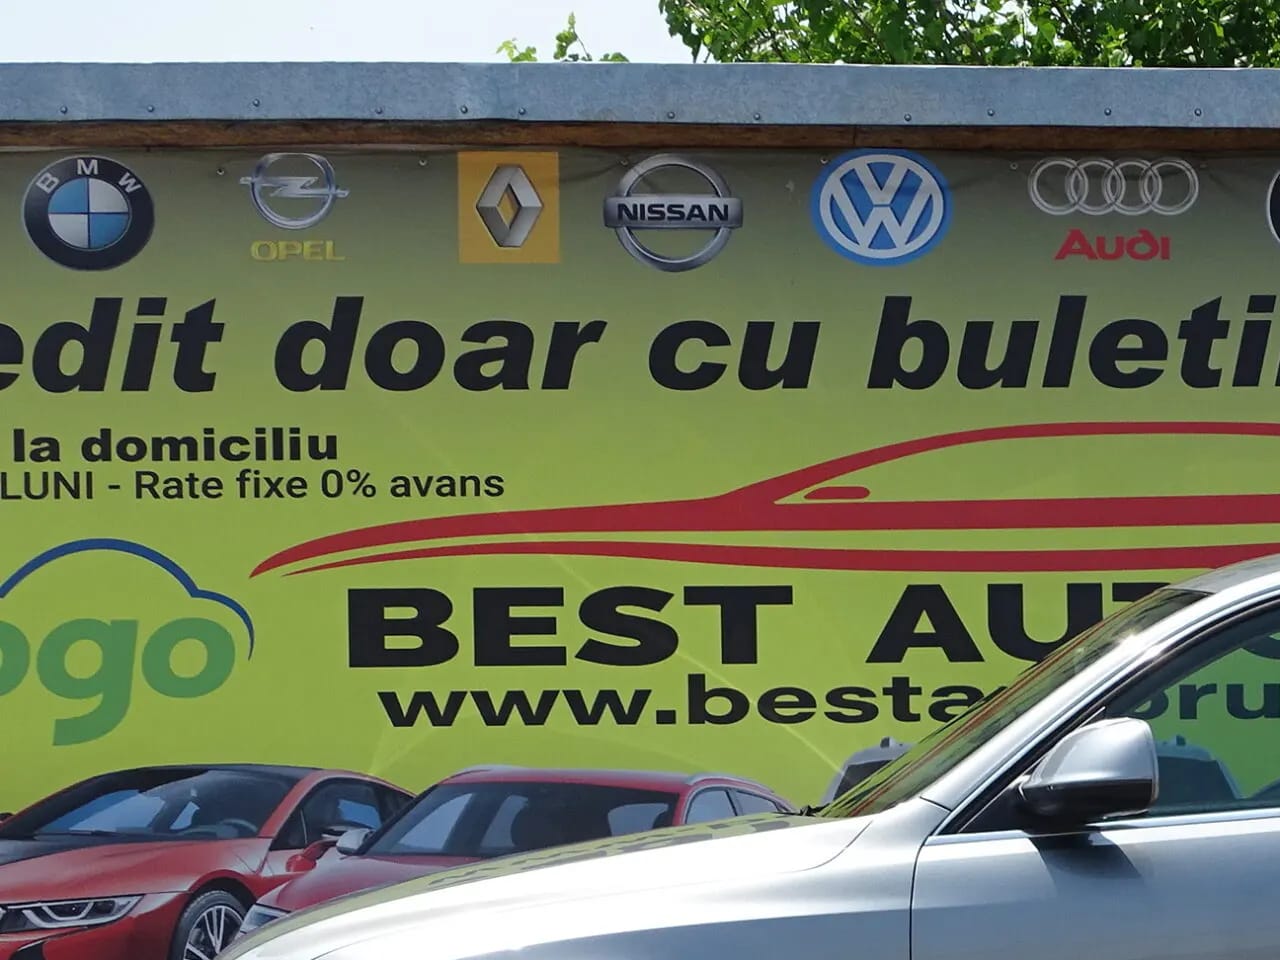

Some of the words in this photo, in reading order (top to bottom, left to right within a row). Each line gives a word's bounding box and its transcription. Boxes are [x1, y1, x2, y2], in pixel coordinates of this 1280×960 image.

[36, 158, 142, 194] BMW
[617, 202, 730, 222] NISSAN
[250, 240, 345, 261] OPEL
[1053, 229, 1171, 261] Audi
[274, 296, 608, 392] doar
[648, 319, 821, 391] cu
[13, 428, 62, 462] la
[81, 427, 339, 462] domiciliu
[0, 471, 94, 501] LUNI
[136, 470, 224, 499] Rate
[236, 468, 308, 498] fixe
[320, 468, 378, 498] 0%
[389, 474, 506, 498] avans
[348, 584, 793, 668] BEST
